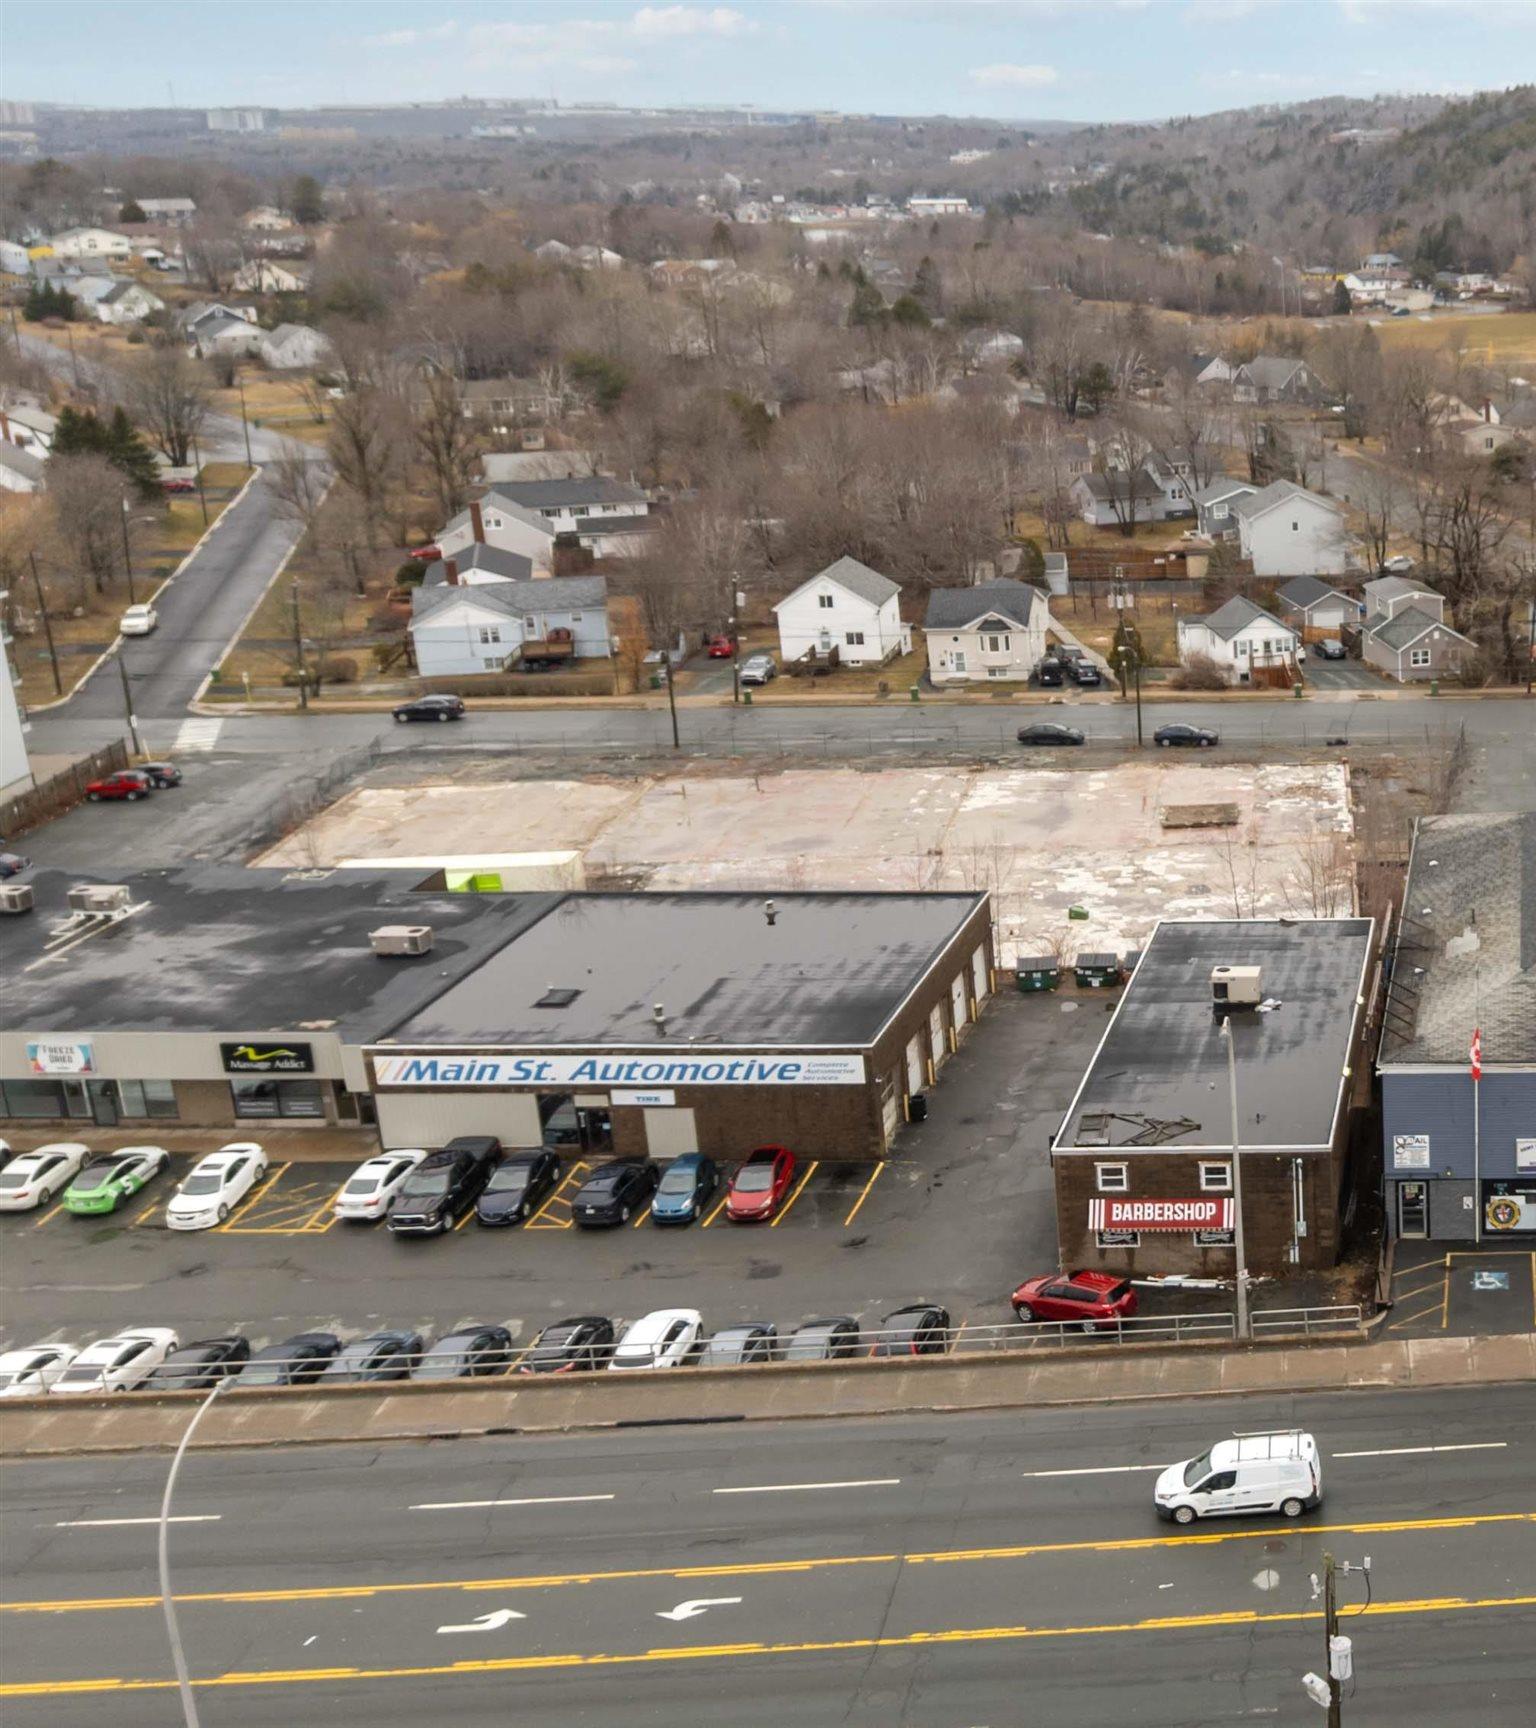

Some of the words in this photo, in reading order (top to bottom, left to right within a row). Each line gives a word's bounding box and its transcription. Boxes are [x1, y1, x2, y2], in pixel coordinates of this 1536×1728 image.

[230, 1061, 272, 1071] Massage
[274, 1059, 306, 1069] Addict
[401, 1059, 501, 1081] Main
[508, 1059, 557, 1081] St.
[568, 1059, 802, 1081] Automotive
[1112, 1202, 1217, 1221] BARBERSHOP
